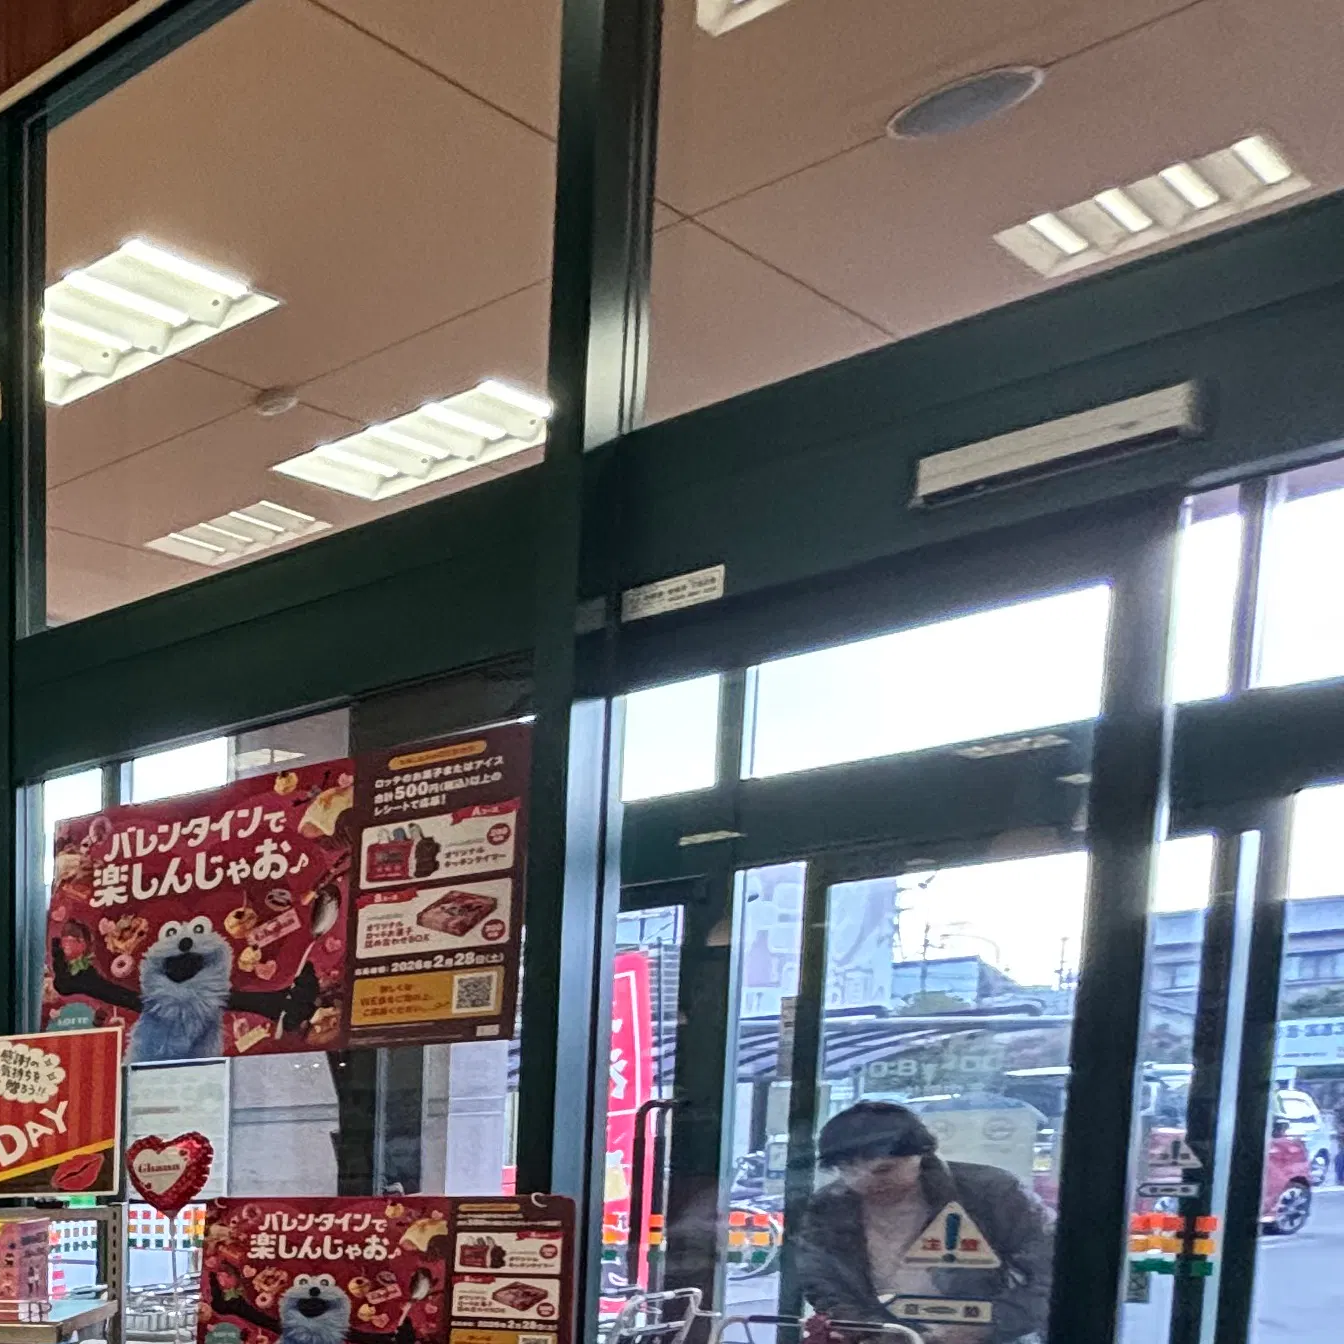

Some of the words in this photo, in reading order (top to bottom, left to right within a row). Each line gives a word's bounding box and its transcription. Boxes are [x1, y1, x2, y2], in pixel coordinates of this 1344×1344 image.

[103, 805, 287, 861] バレンタインで
[257, 1211, 387, 1233] バレンタインで
